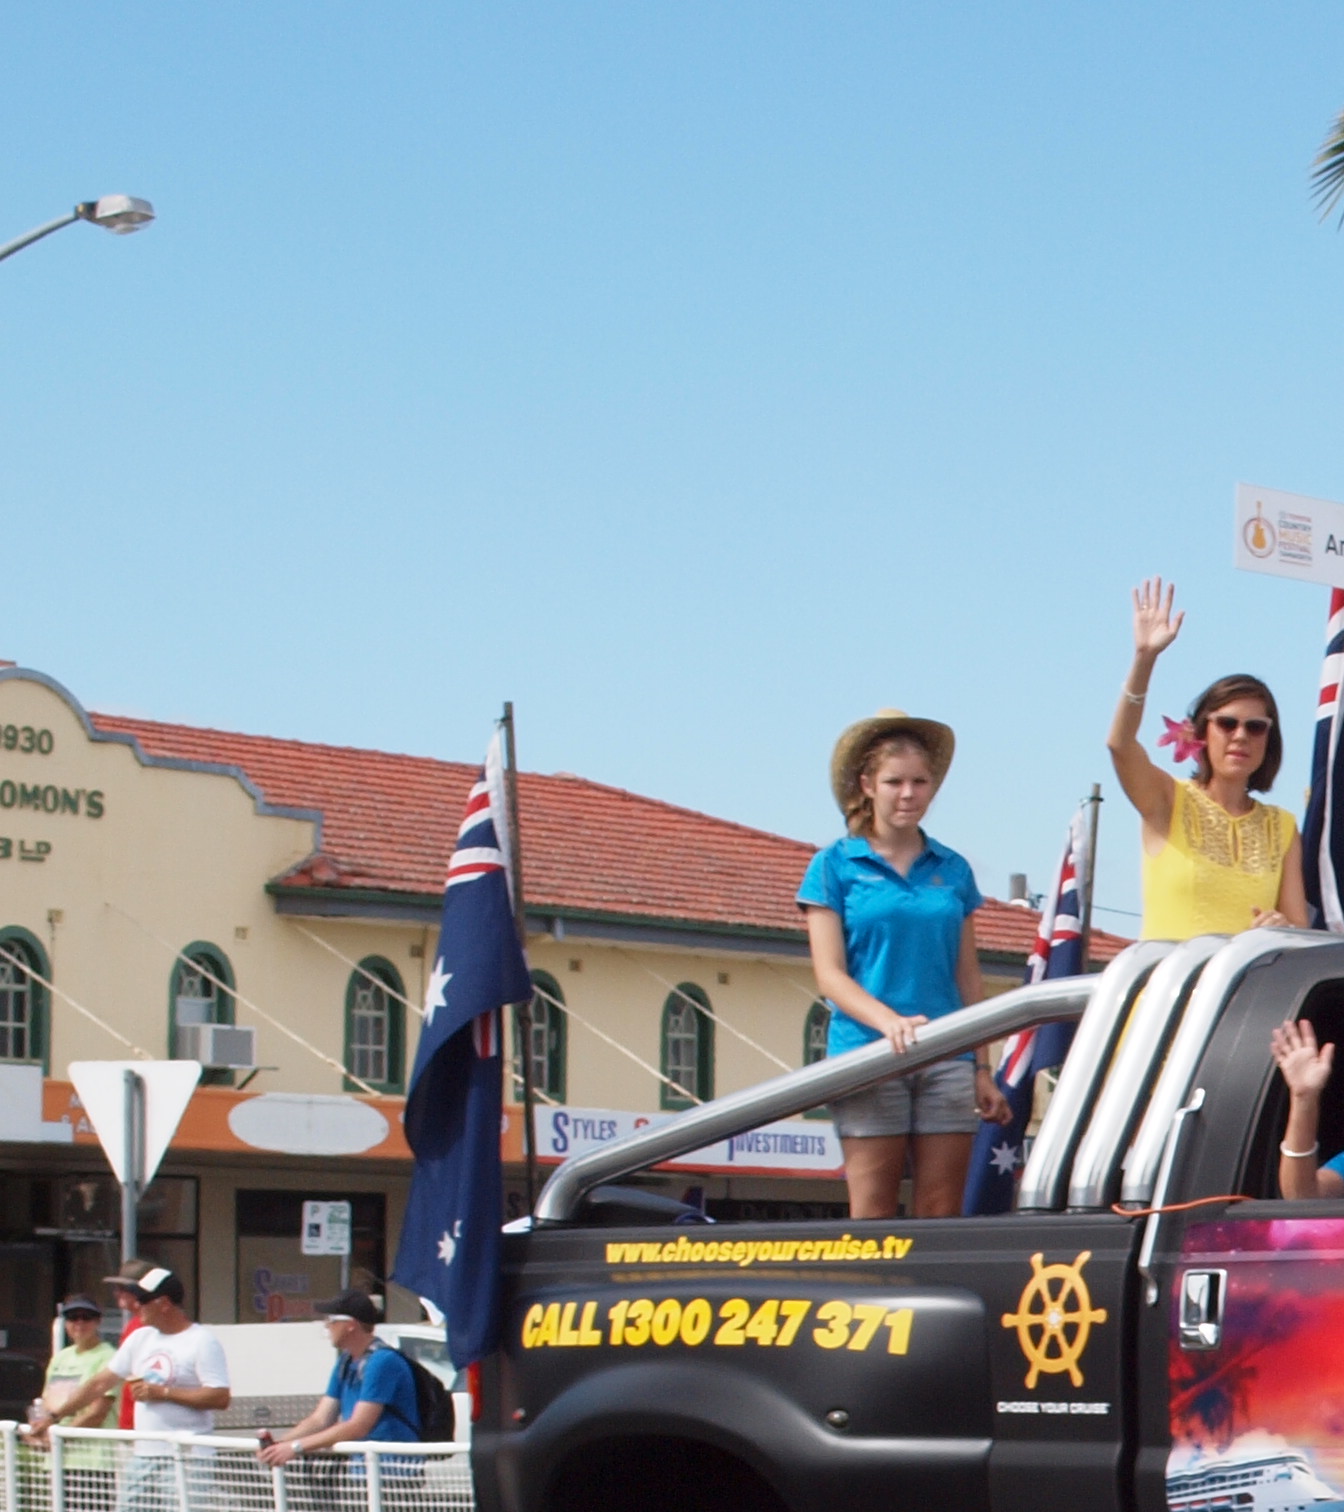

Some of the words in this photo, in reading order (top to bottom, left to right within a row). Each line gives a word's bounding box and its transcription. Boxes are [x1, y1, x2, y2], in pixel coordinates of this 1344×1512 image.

[0, 724, 54, 756] 930
[605, 1234, 913, 1267] www.chooseyourcruise.tv
[521, 1301, 602, 1349] CALL
[608, 1298, 712, 1347] 1300
[713, 1299, 812, 1346] 247
[812, 1300, 914, 1355] 371
